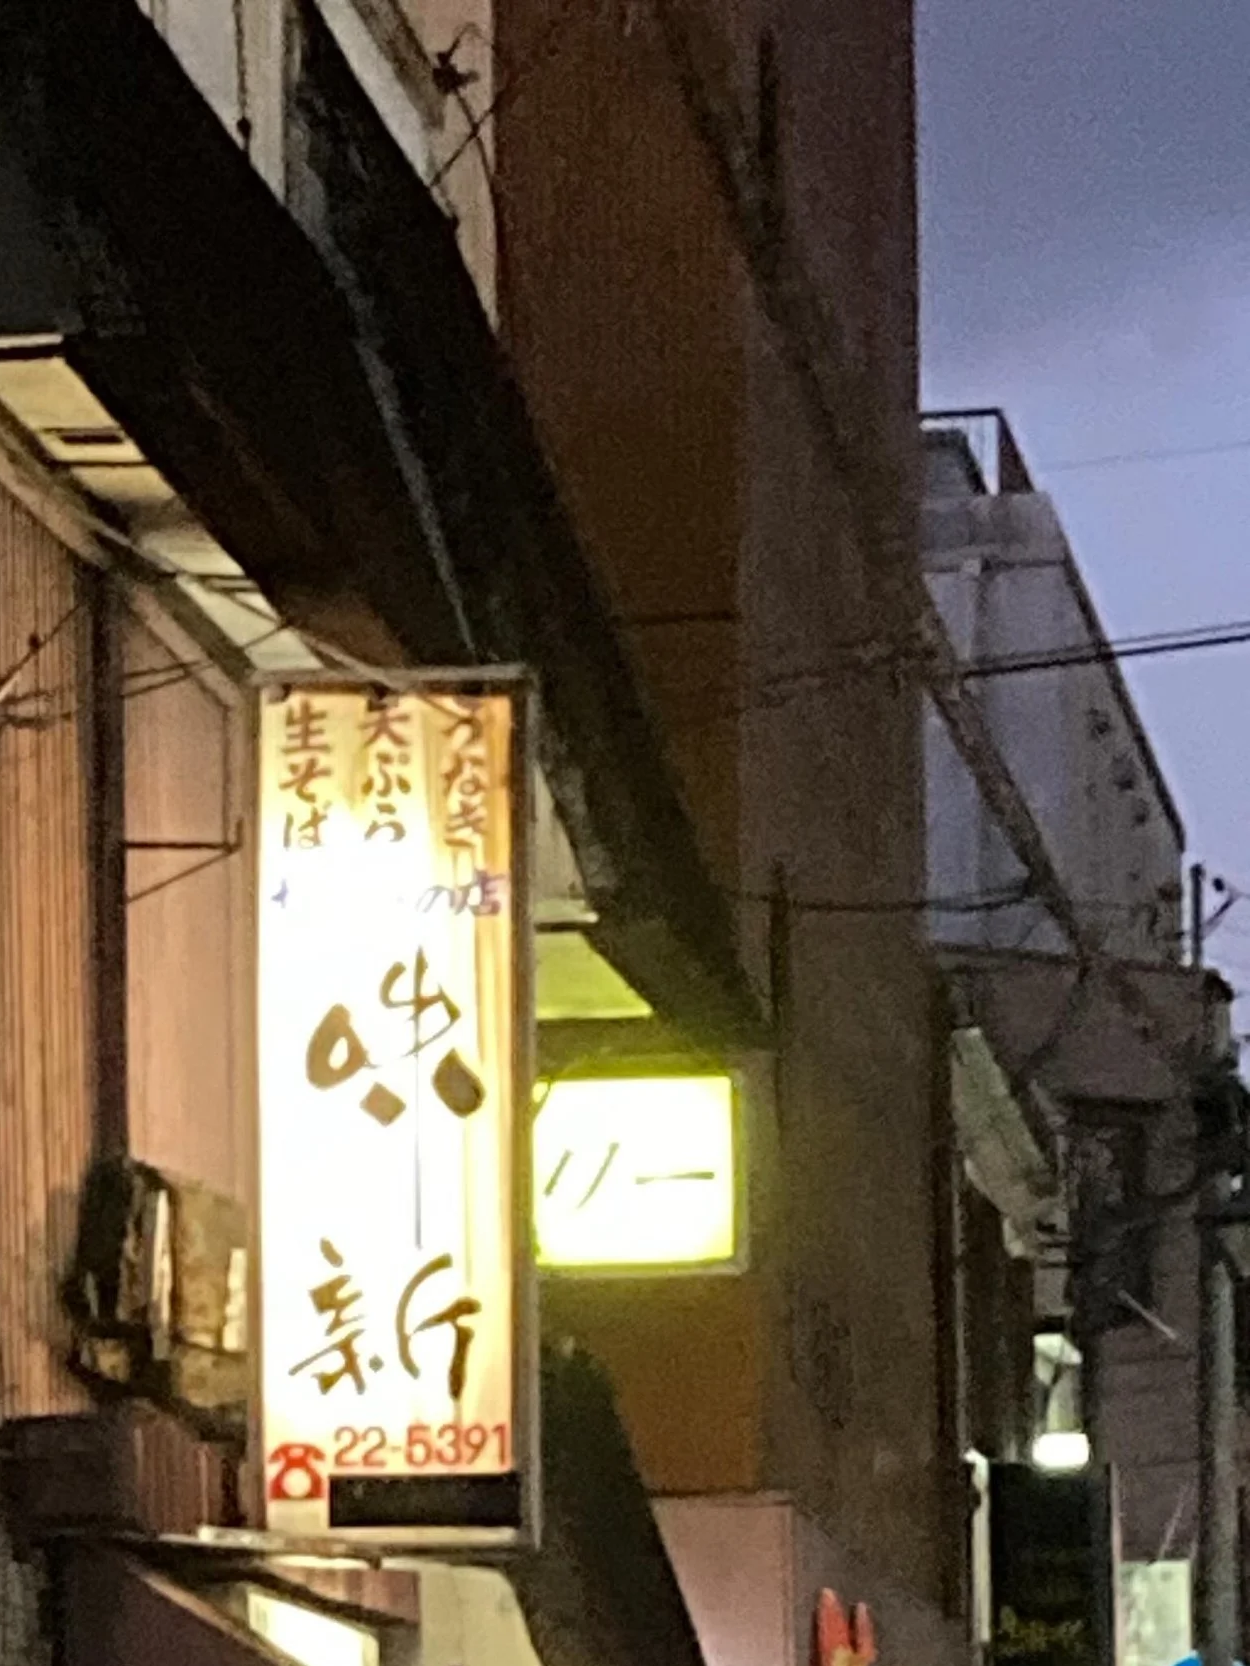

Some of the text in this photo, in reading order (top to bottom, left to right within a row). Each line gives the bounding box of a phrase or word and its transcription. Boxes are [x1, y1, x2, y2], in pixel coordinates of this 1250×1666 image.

[278, 697, 333, 850] 生そば
[356, 692, 412, 843] 天ぷら
[333, 1423, 510, 1469] 22-5391
